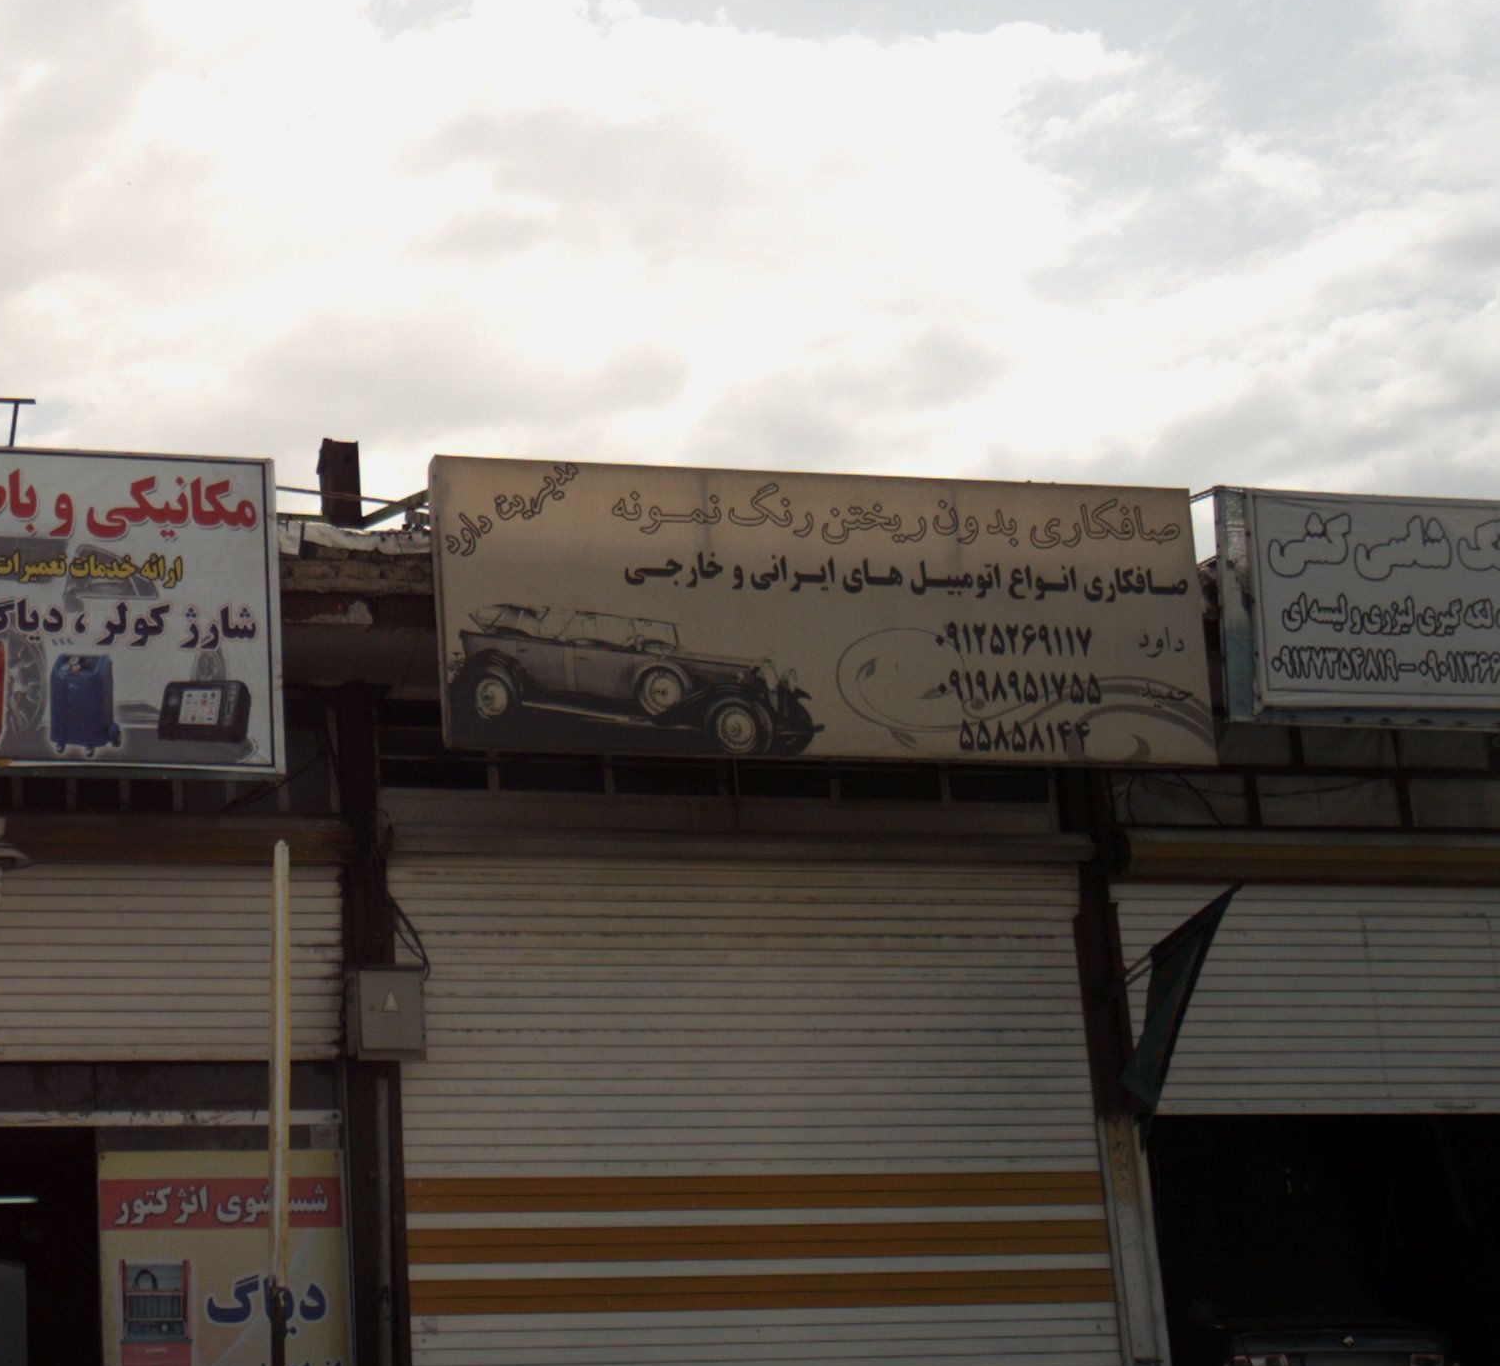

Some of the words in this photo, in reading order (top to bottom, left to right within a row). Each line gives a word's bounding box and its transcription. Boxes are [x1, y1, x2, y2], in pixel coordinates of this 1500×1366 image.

[86, 476, 257, 539] مکانیکی
[494, 462, 579, 521] مدیریت
[728, 483, 814, 538] رنگ
[49, 492, 74, 537] و
[611, 490, 722, 535] نمونه
[821, 503, 927, 545] ریختن
[933, 500, 1018, 547] بدون
[1030, 497, 1181, 549] صافکاری
[445, 512, 493, 557] داود
[69, 553, 138, 580] خدمات
[141, 553, 183, 589] ارائه
[624, 552, 723, 587] خارجی
[732, 565, 744, 590] و
[751, 553, 835, 592] ایرانی
[843, 558, 903, 593] های
[911, 563, 1000, 598] اتومبیل
[1008, 564, 1077, 600] انواع
[1084, 566, 1189, 603] صافکاری
[96, 601, 170, 647] کولر
[179, 605, 257, 649] شارژ
[1363, 595, 1415, 635] لیزری
[1416, 598, 1462, 637] گیری
[1138, 626, 1185, 658] داود
[938, 669, 1102, 704] ۰۹۱۹۸۹۵۱۷۵۵
[1141, 683, 1193, 708] حمید
[959, 719, 1091, 752] ۵۵۸۵۸۱۴۴
